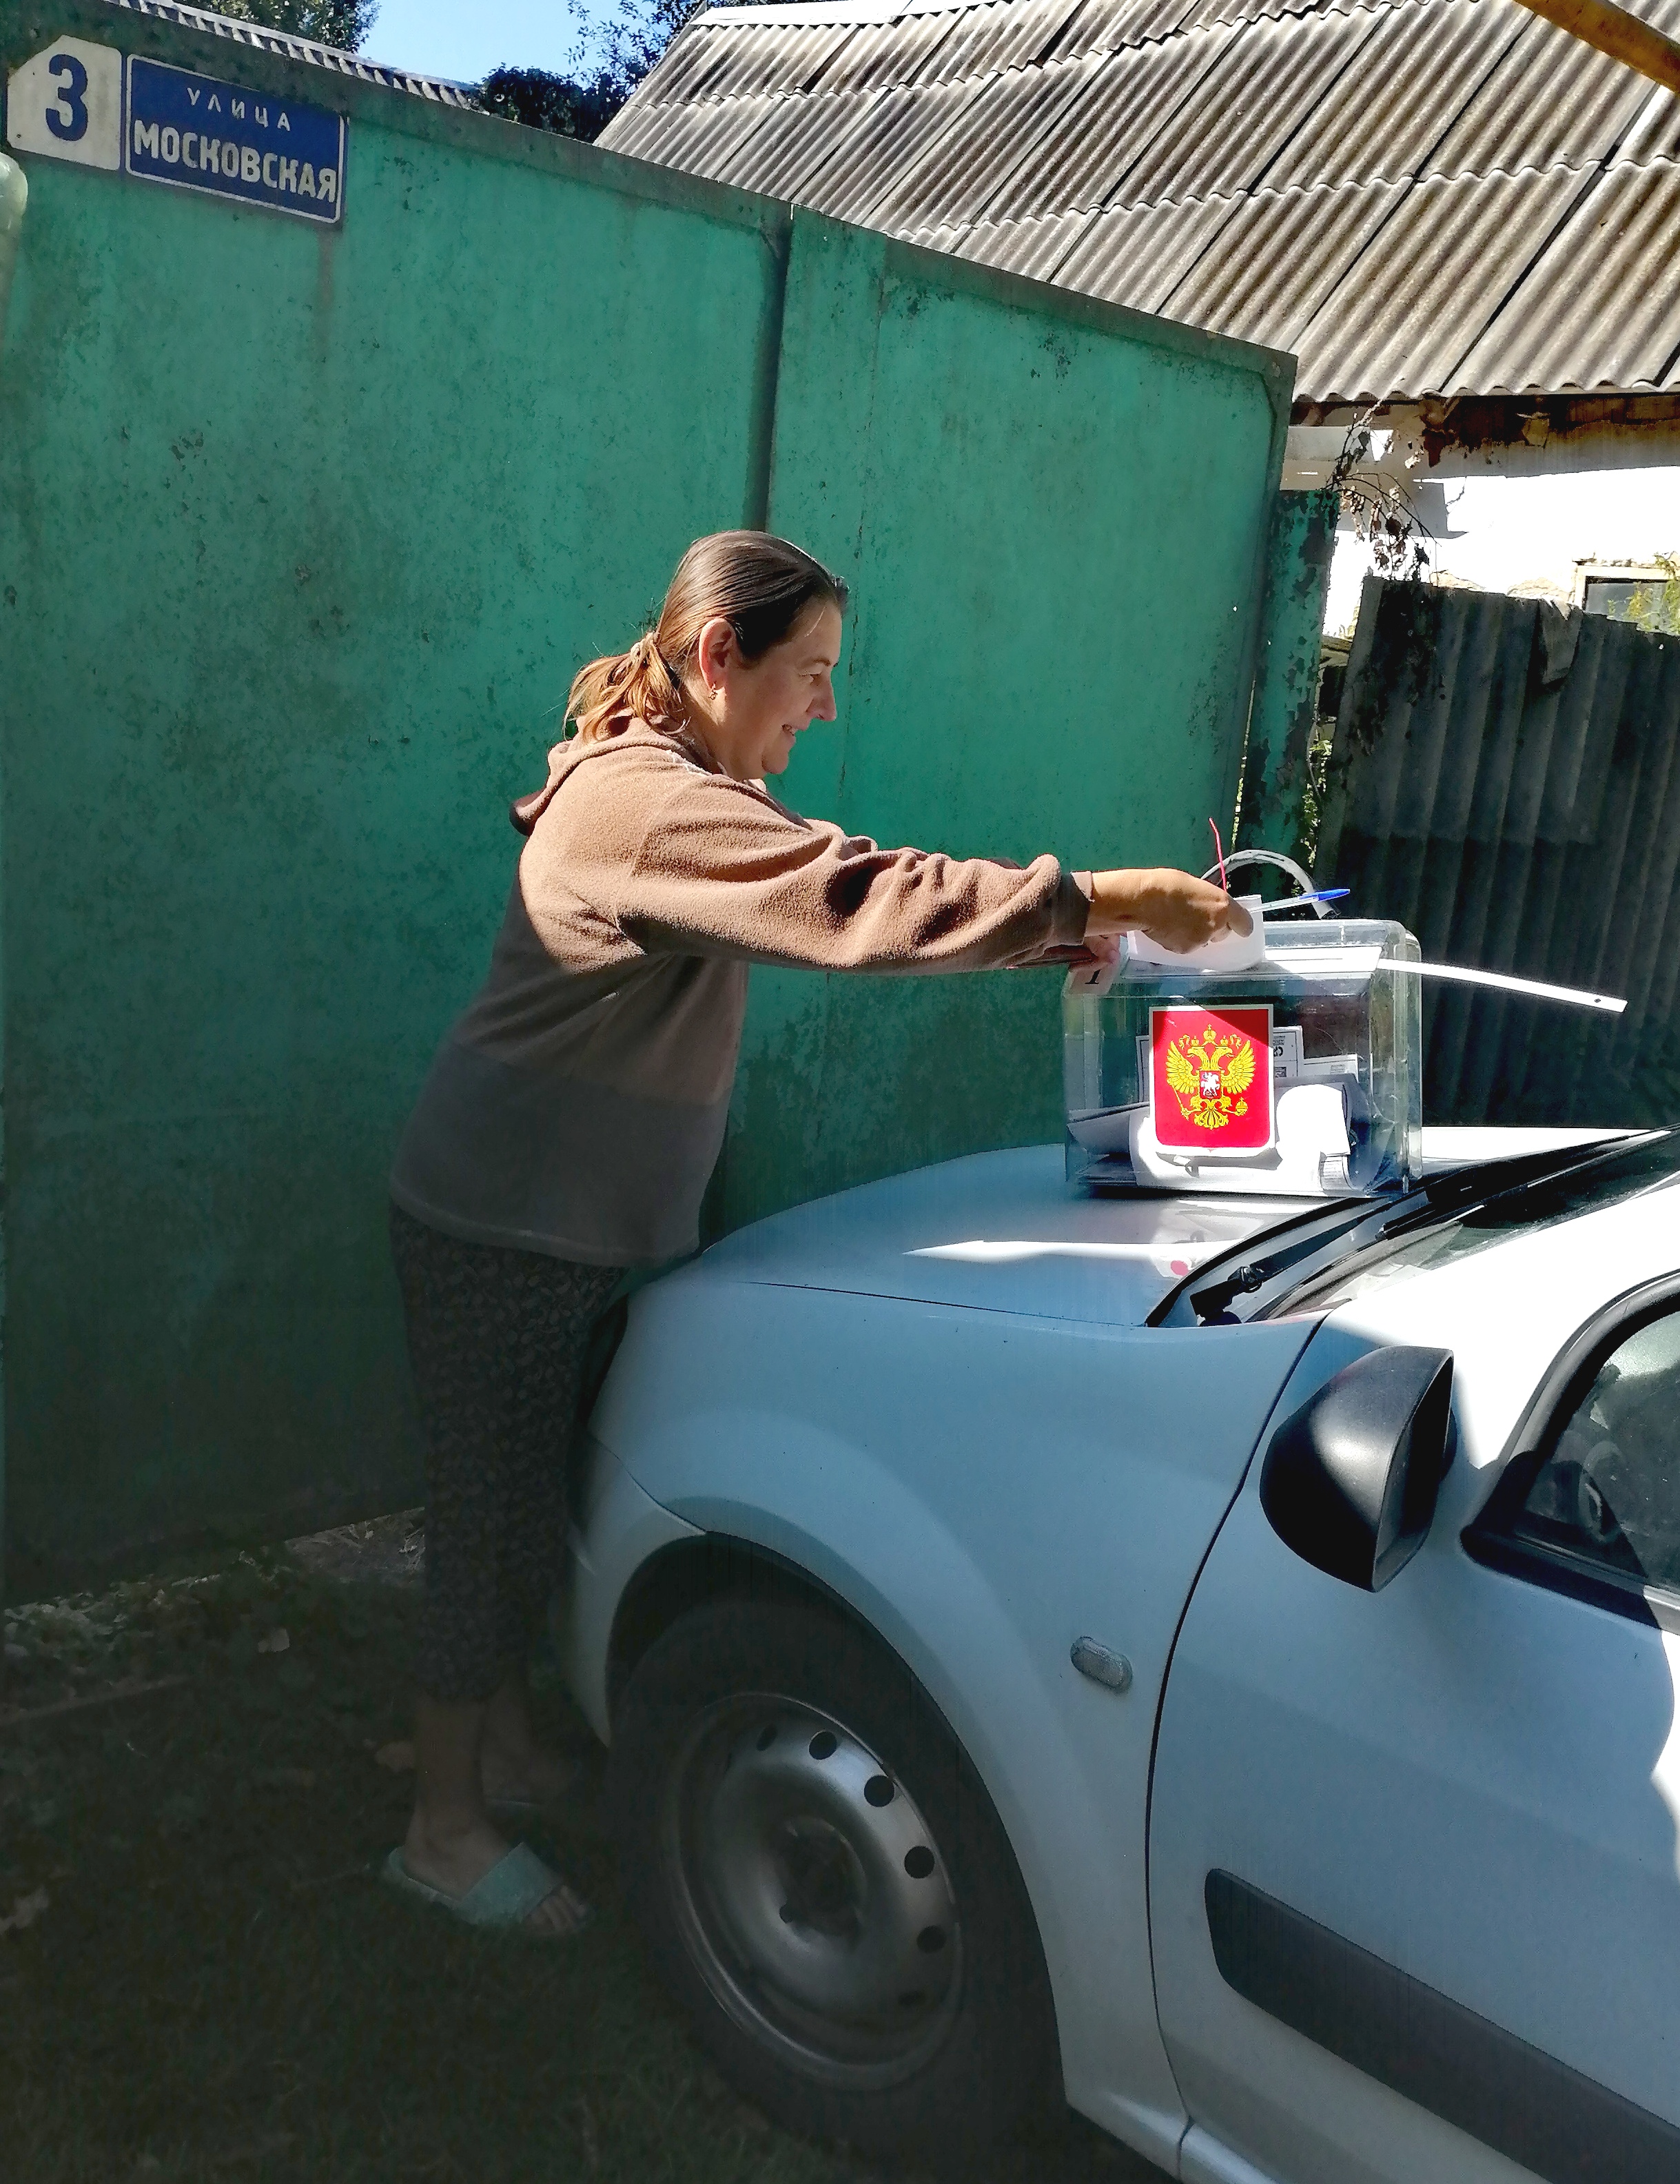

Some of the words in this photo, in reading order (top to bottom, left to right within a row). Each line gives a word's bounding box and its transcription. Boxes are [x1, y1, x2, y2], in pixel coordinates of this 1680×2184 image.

[45, 54, 88, 141] 3
[187, 87, 291, 131] УЛИЦА
[134, 119, 337, 203] МОСКОВСКАЯ
